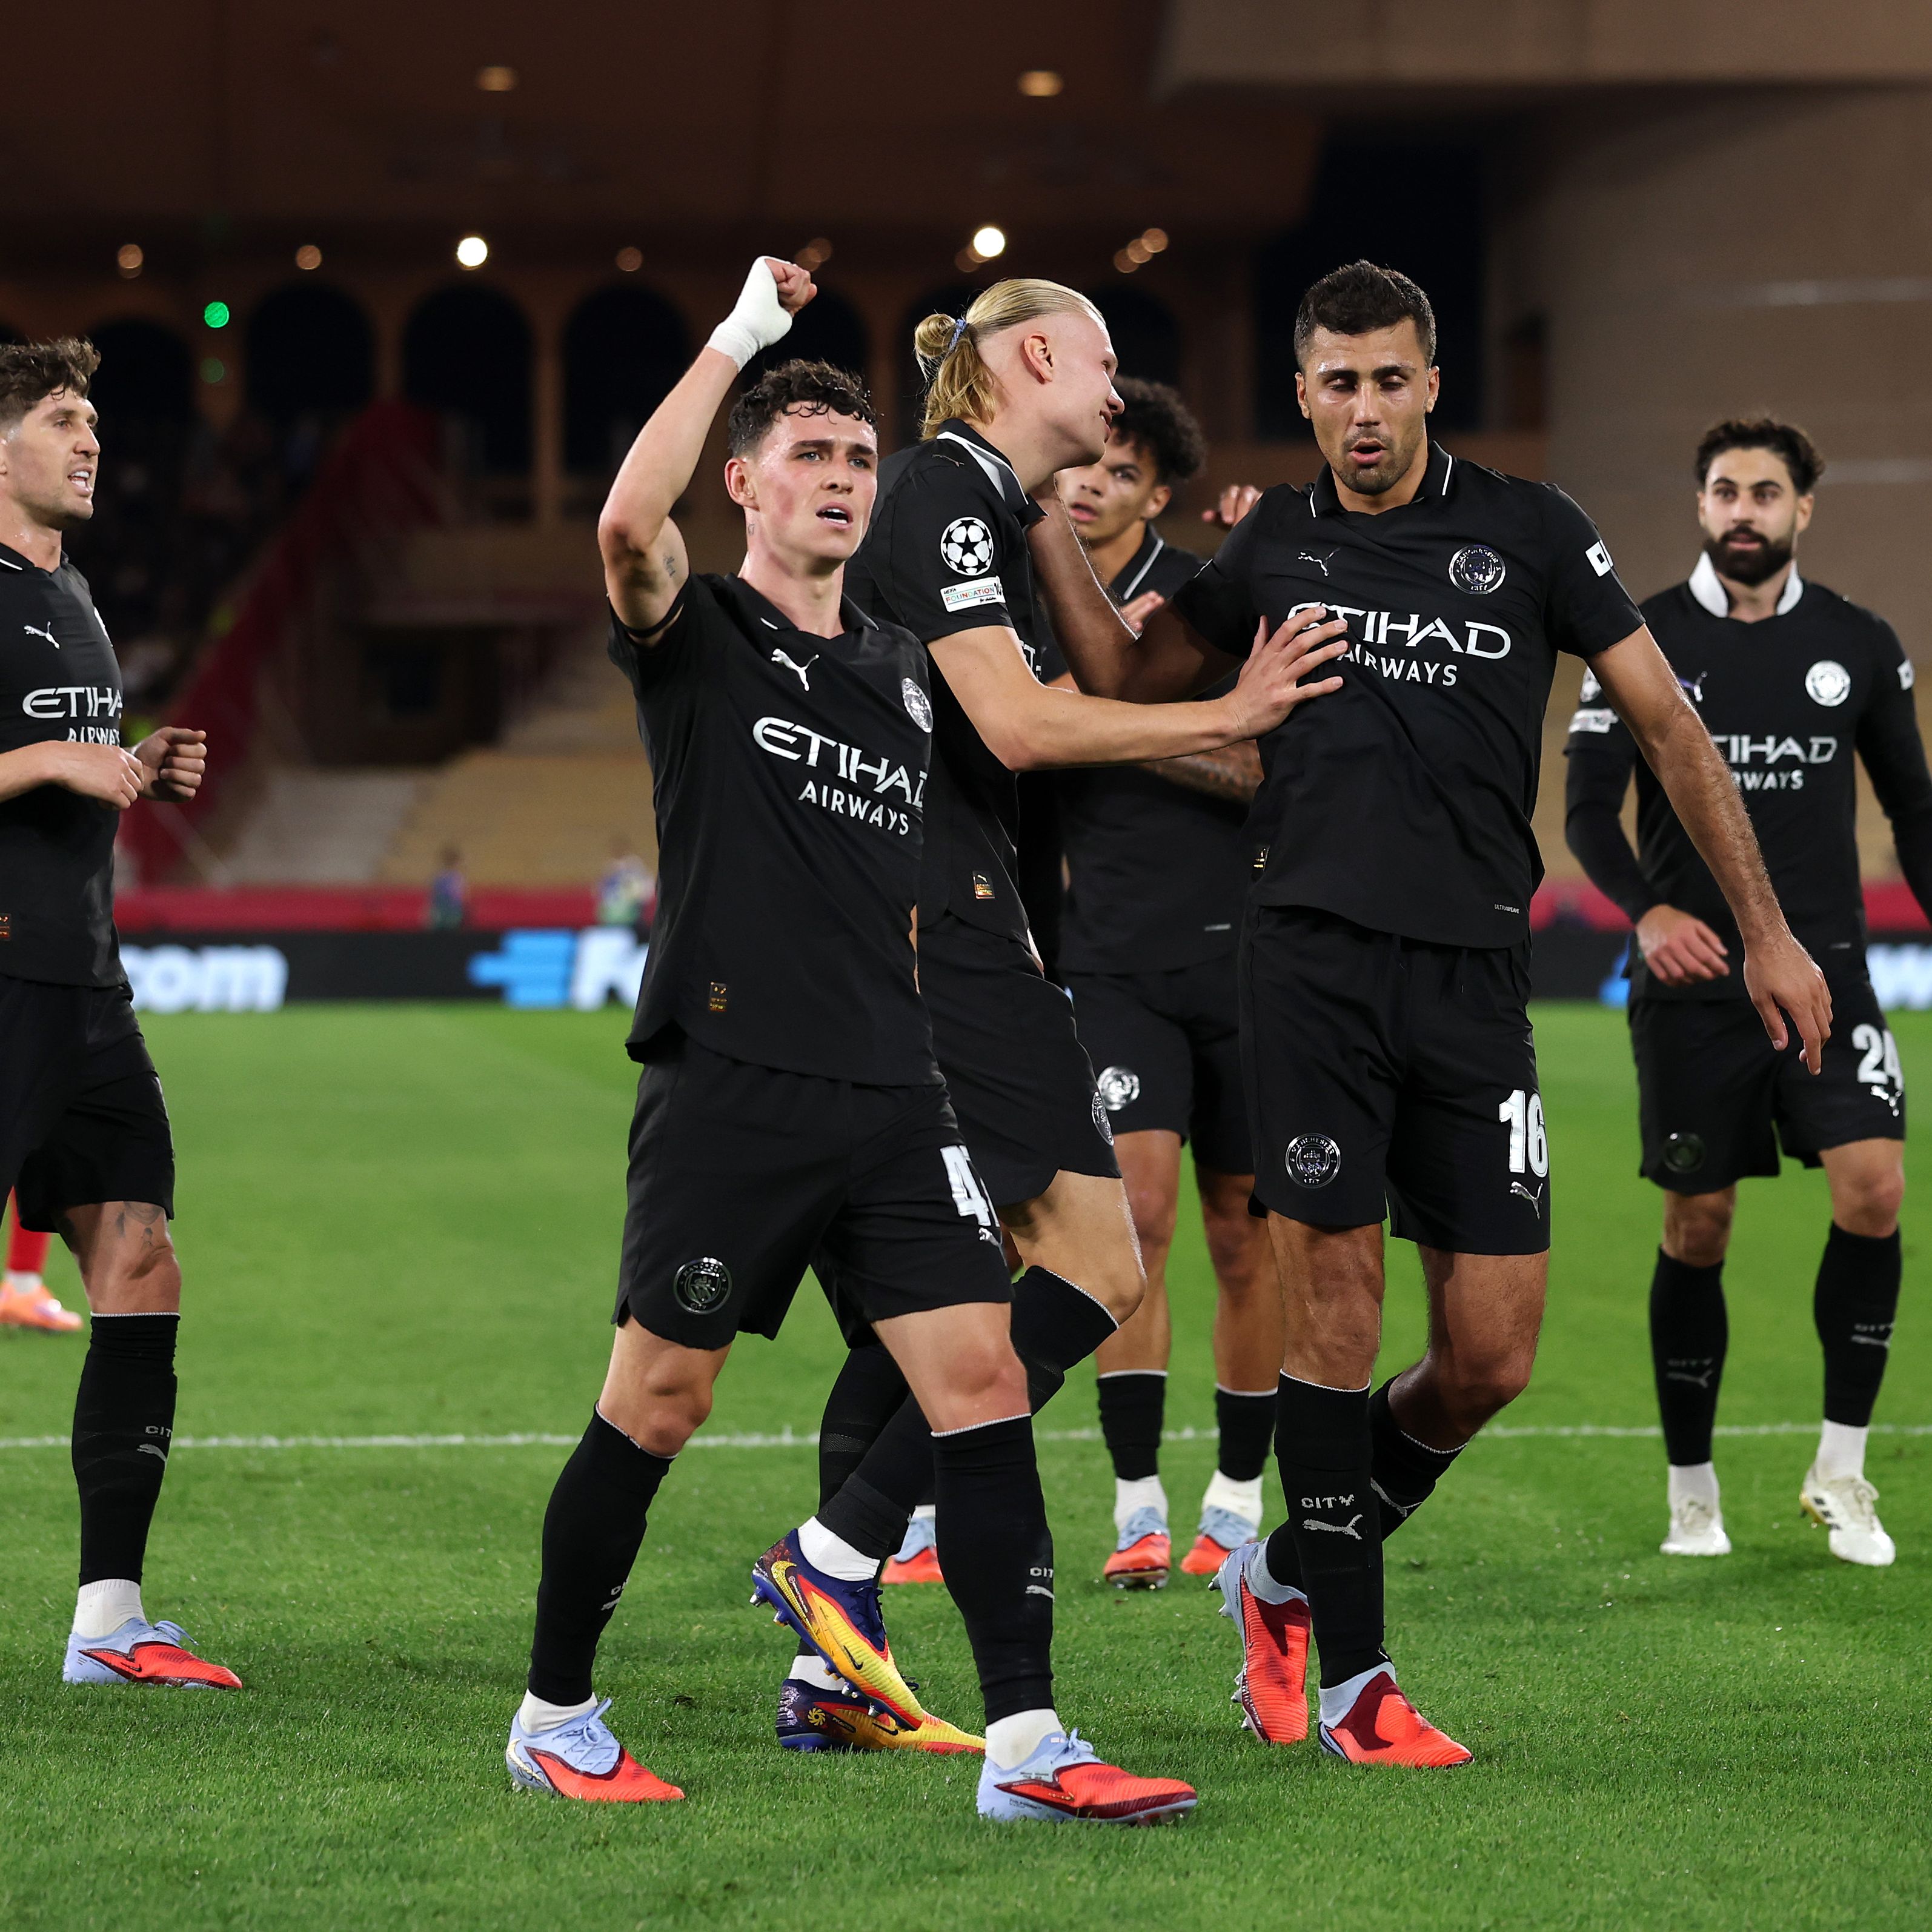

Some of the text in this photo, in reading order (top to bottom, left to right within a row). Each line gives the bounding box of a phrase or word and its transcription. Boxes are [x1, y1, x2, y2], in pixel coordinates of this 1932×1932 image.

[946, 587, 995, 603] FOUNDATION
[798, 780, 909, 835] AIRWAYS
[1499, 1089, 1549, 1178] 16
[1301, 1494, 1355, 1509] CITY
